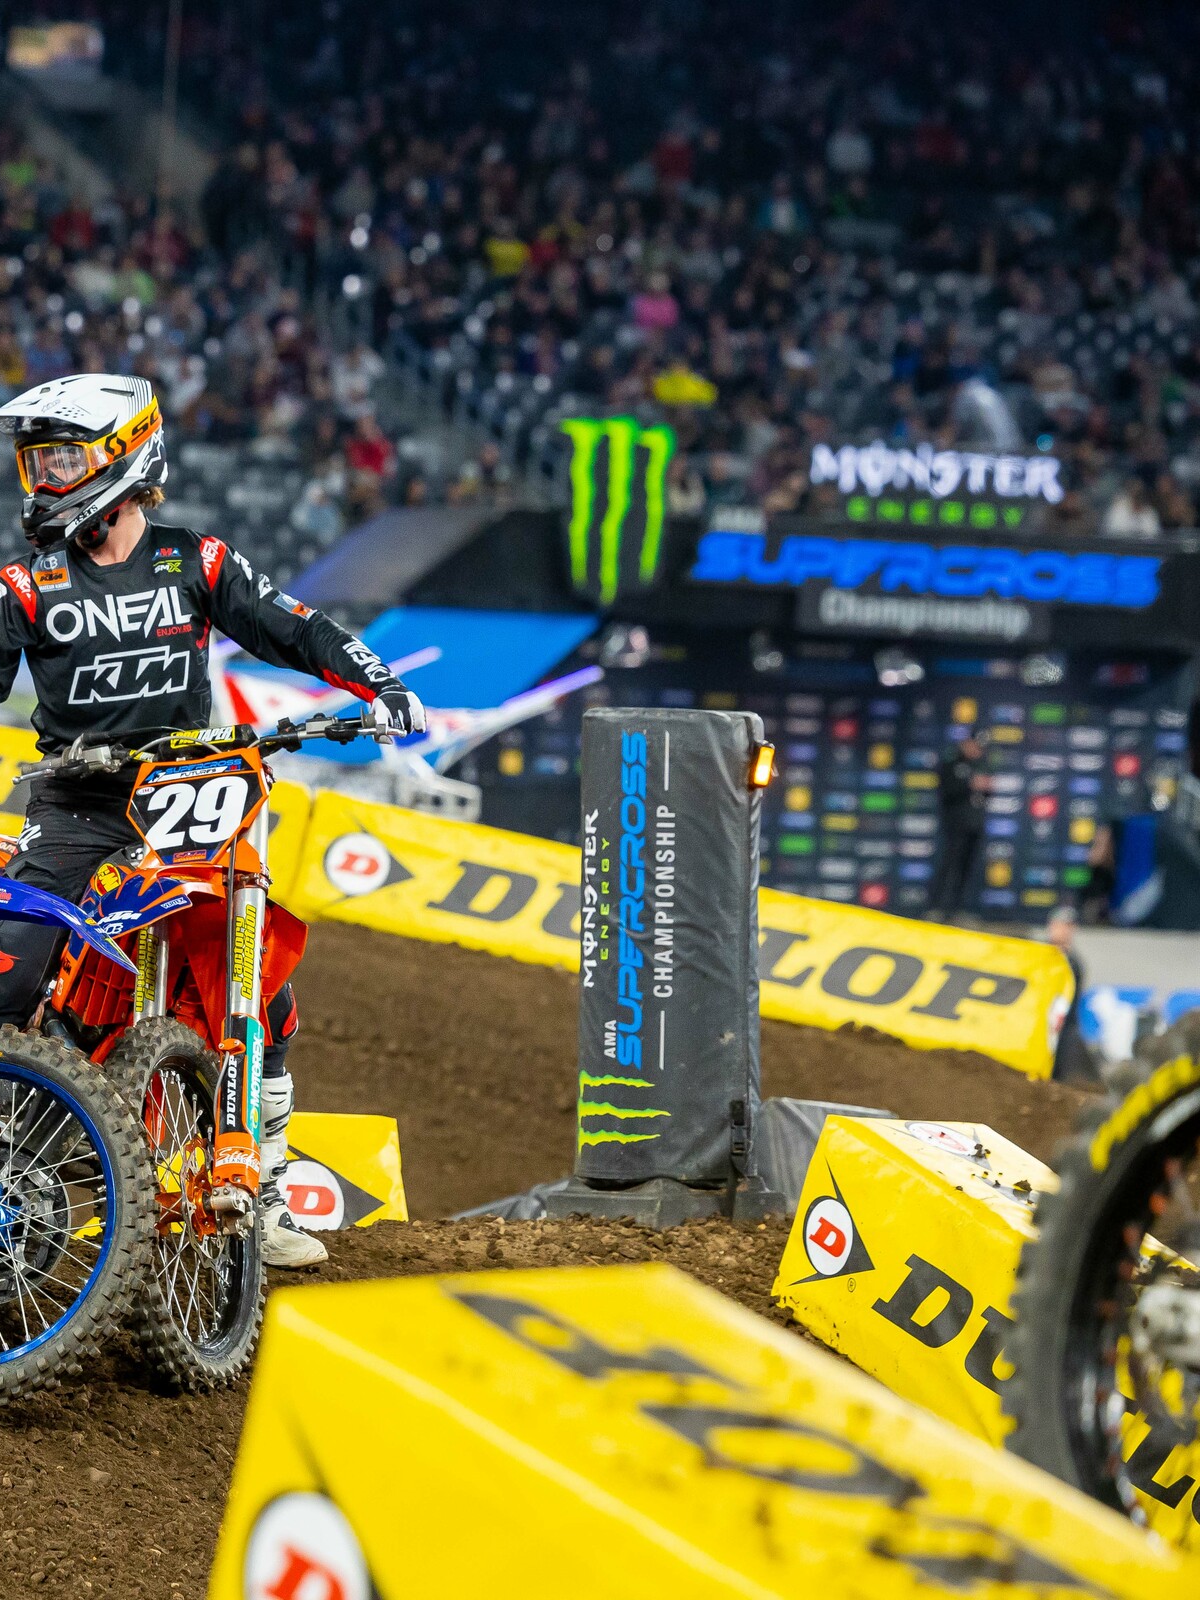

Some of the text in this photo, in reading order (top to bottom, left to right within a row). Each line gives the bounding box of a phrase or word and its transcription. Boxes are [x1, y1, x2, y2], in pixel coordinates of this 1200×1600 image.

[810, 440, 1063, 503] MONSTER
[693, 531, 1163, 608] SUPERCROSS
[820, 589, 1031, 641] Championship
[68, 645, 191, 706] KTM
[144, 776, 249, 851] 29
[583, 809, 599, 988] MONSTER
[601, 836, 610, 961] ENERGY
[616, 730, 647, 1073] SUPERCROSS
[653, 804, 677, 999] CHAMPIONSHIP
[232, 916, 246, 982] Factory
[241, 904, 258, 1001] Connection
[427, 858, 1028, 1023] DULOP
[249, 1035, 264, 1108] MOTOREX
[603, 1019, 617, 1059] AMA
[226, 1054, 239, 1128] DUNLOP
[286, 1184, 336, 1216] D
[808, 1216, 847, 1258] D
